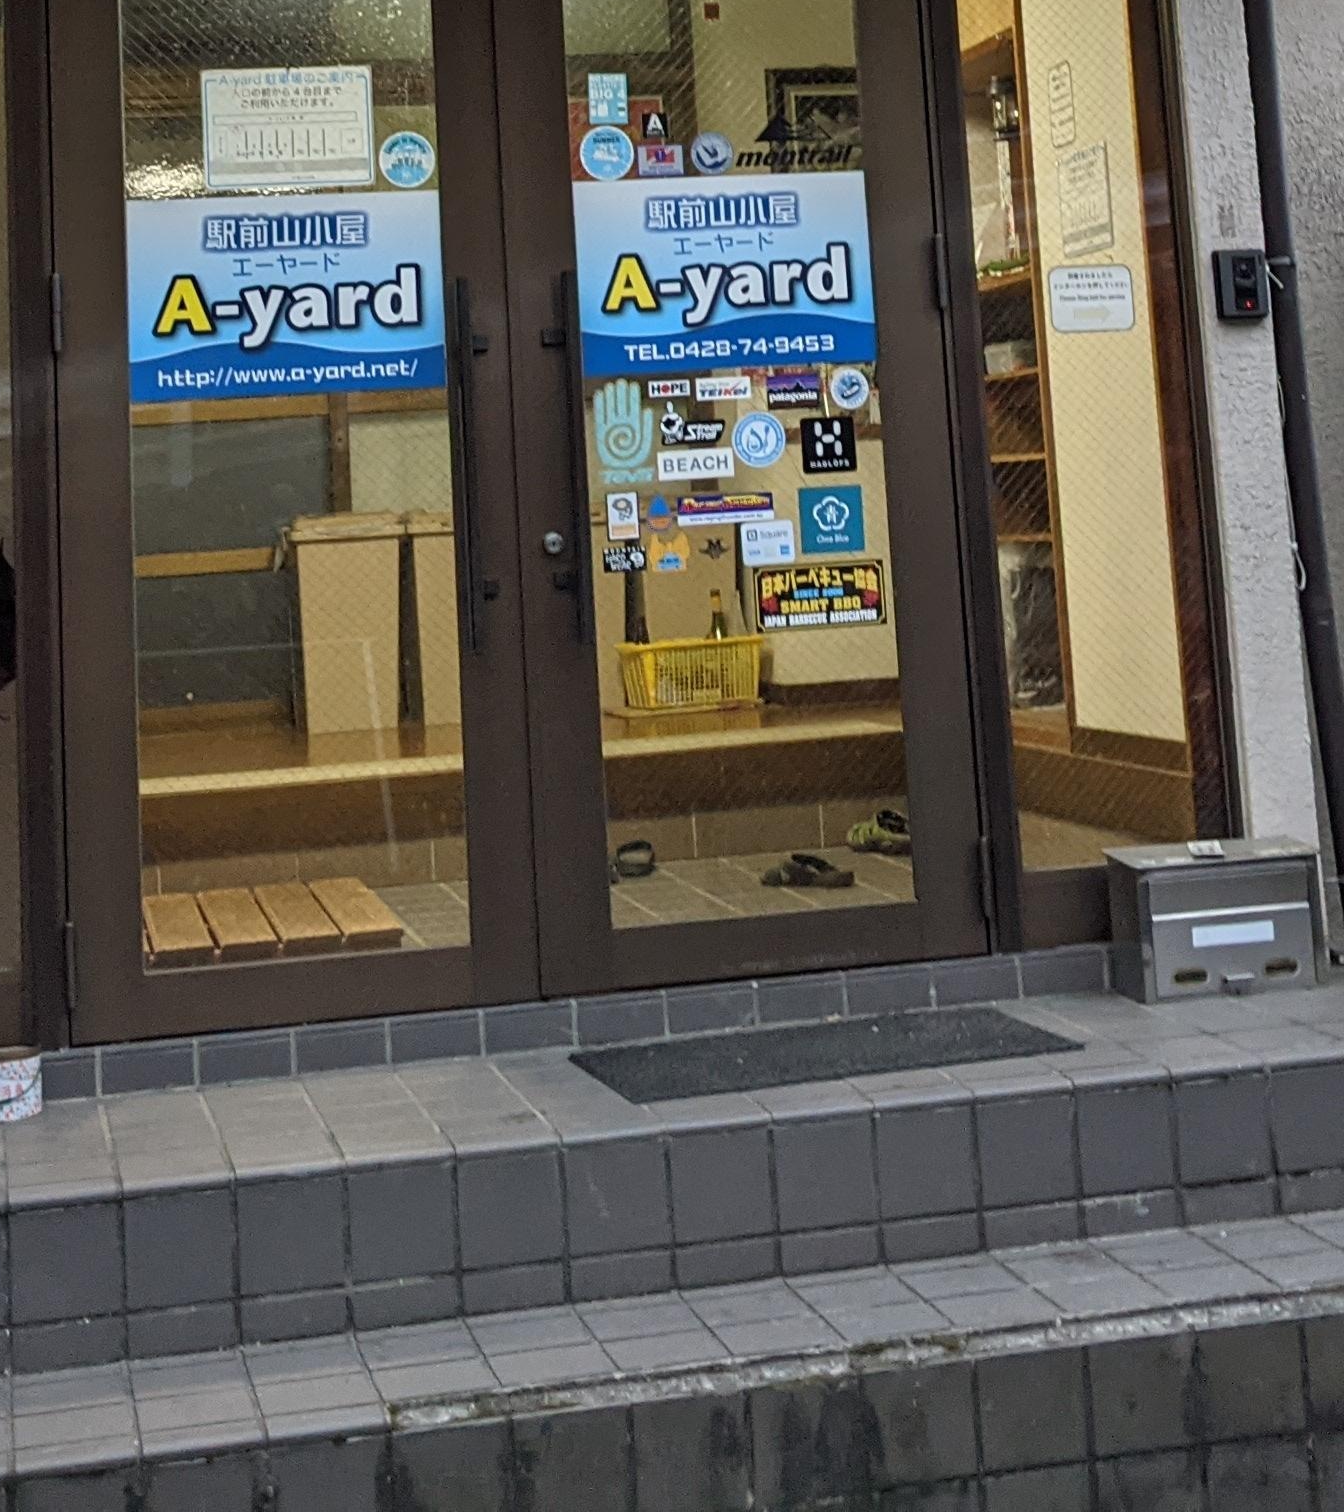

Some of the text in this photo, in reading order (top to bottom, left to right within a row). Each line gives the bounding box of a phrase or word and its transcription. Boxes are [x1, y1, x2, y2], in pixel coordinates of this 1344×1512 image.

[736, 143, 853, 167] montrail
[647, 194, 797, 229] 駅前山小屋
[205, 214, 366, 249] 駅前山小屋
[673, 231, 774, 256] エーヤード
[232, 252, 340, 276] エーヤード
[604, 244, 850, 326] A-yard
[154, 265, 420, 350] A-yard
[624, 334, 835, 362] TEL.0428-74-9453
[158, 359, 418, 388] http://www.a-yard.net/
[651, 382, 687, 394] HOPE
[768, 390, 818, 404] patagonia
[662, 454, 729, 472] BEACH
[761, 567, 878, 599] 日本バーベキュー協会
[780, 595, 861, 614] SMART BBQ
[764, 614, 786, 627] JAPAN
[830, 608, 877, 624] ASSOCIATION
